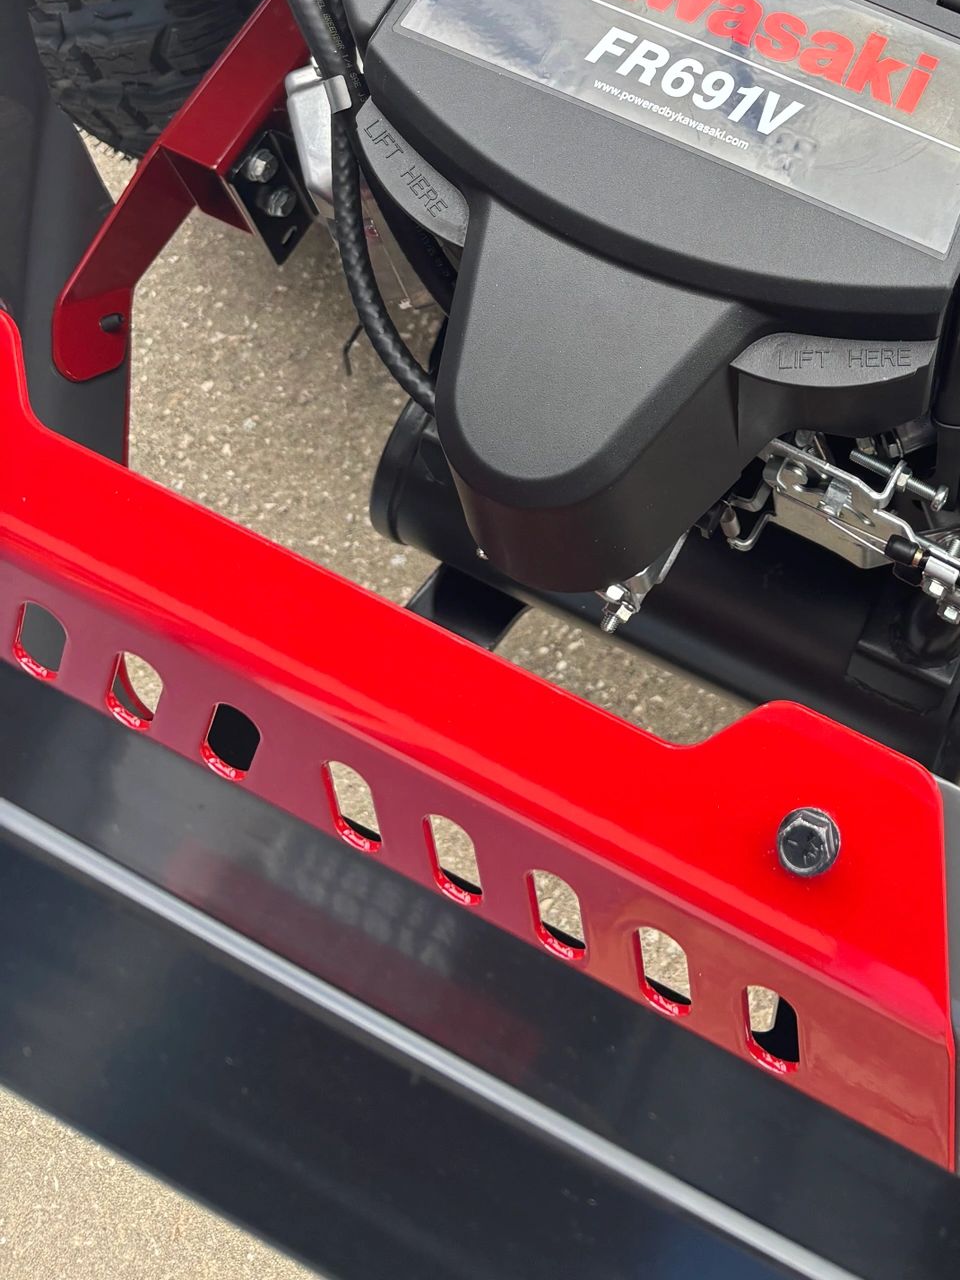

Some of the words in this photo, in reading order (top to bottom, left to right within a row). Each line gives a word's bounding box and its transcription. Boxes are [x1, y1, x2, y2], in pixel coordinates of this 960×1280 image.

[583, 26, 805, 136] FR691V
[592, 78, 750, 151] www.poweredbykawasaki.com
[364, 119, 404, 159] LIFT
[400, 165, 448, 218] HERE
[778, 349, 830, 370] LIFT
[847, 348, 912, 368] HERE
